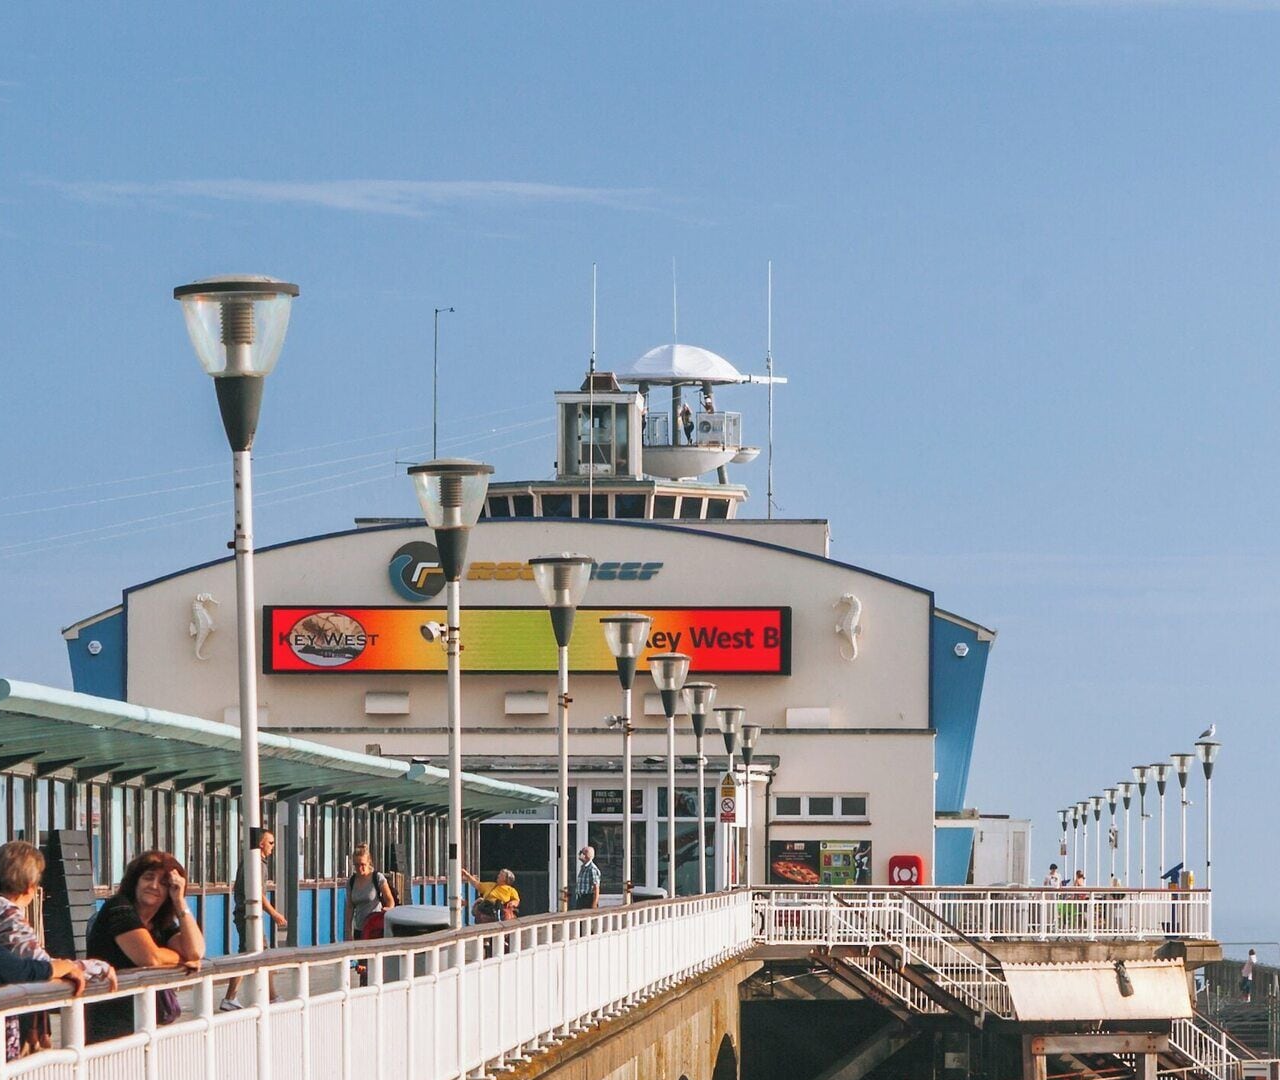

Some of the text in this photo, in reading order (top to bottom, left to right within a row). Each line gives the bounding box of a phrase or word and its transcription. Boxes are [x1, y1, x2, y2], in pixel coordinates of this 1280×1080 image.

[466, 562, 664, 581] RO EEF
[278, 631, 380, 647] KEY WEST
[689, 626, 755, 649] West
